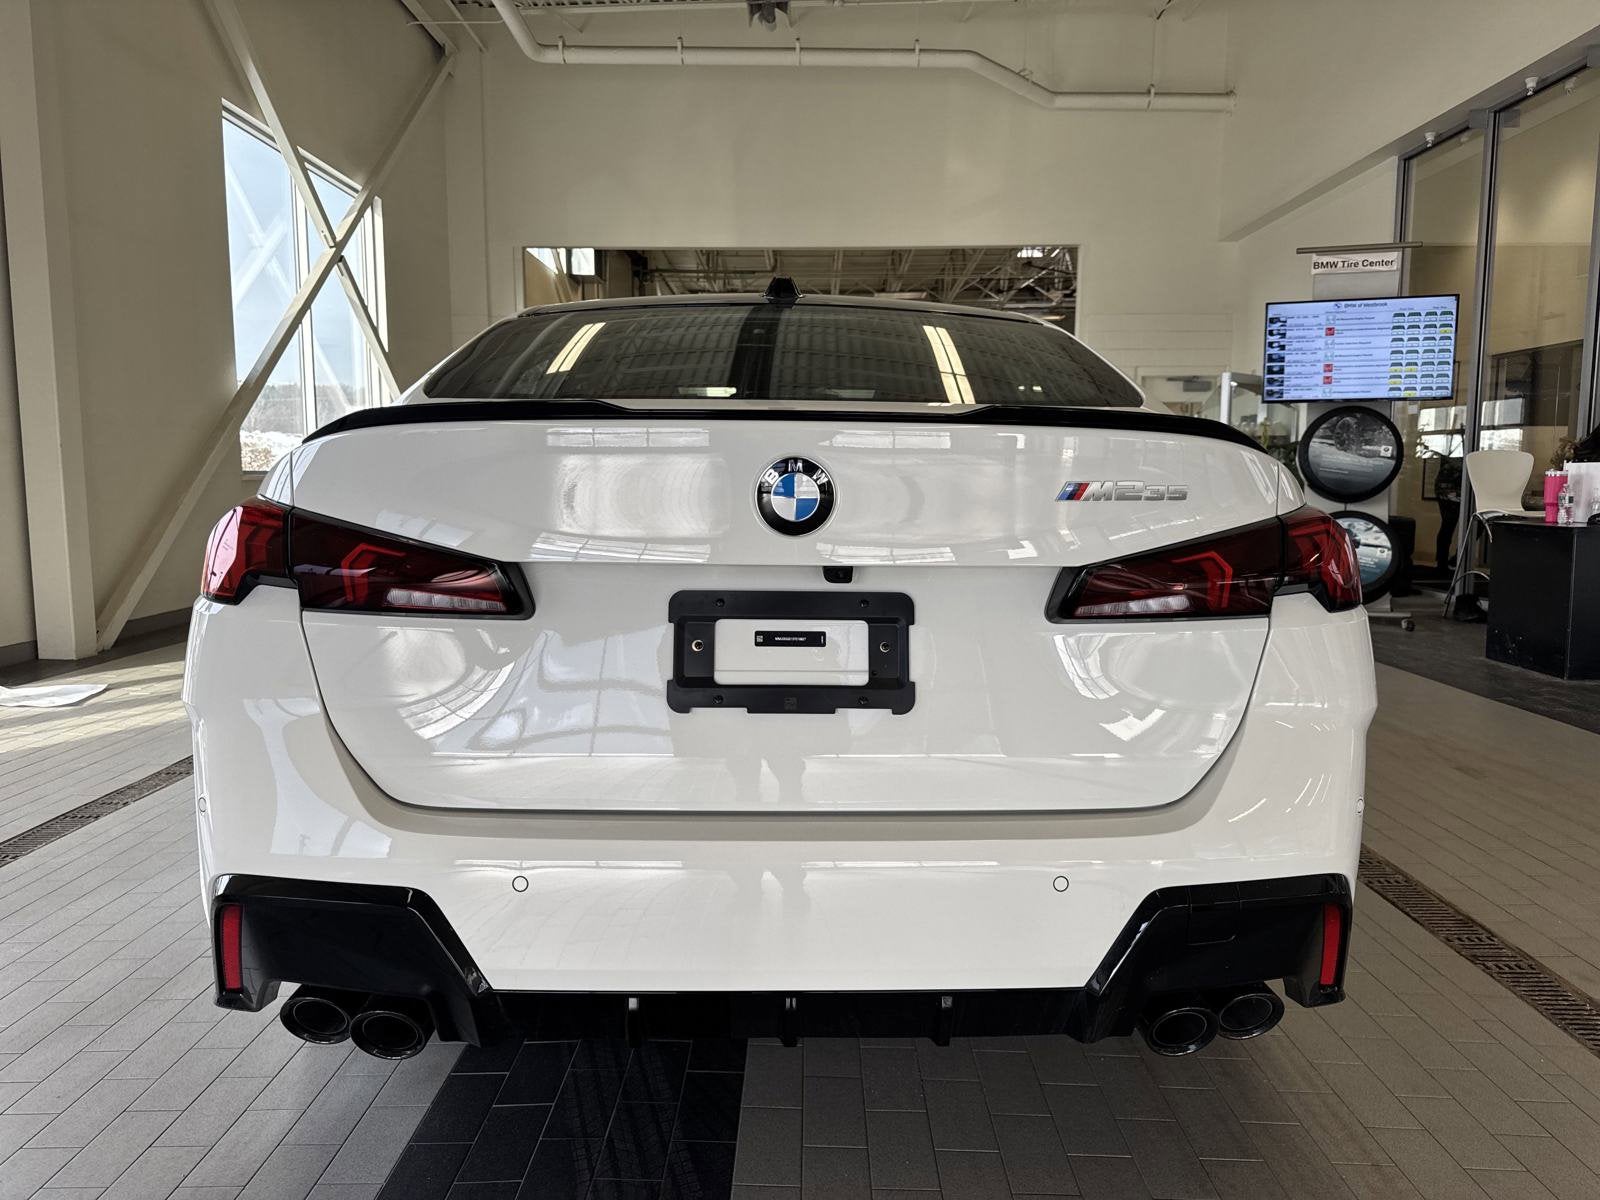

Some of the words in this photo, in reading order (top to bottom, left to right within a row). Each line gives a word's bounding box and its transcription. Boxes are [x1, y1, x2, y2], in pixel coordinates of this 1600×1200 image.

[1313, 261, 1338, 269] BMW
[1362, 259, 1394, 267] Center
[764, 459, 828, 484] BMW
[1080, 480, 1188, 501] M235
